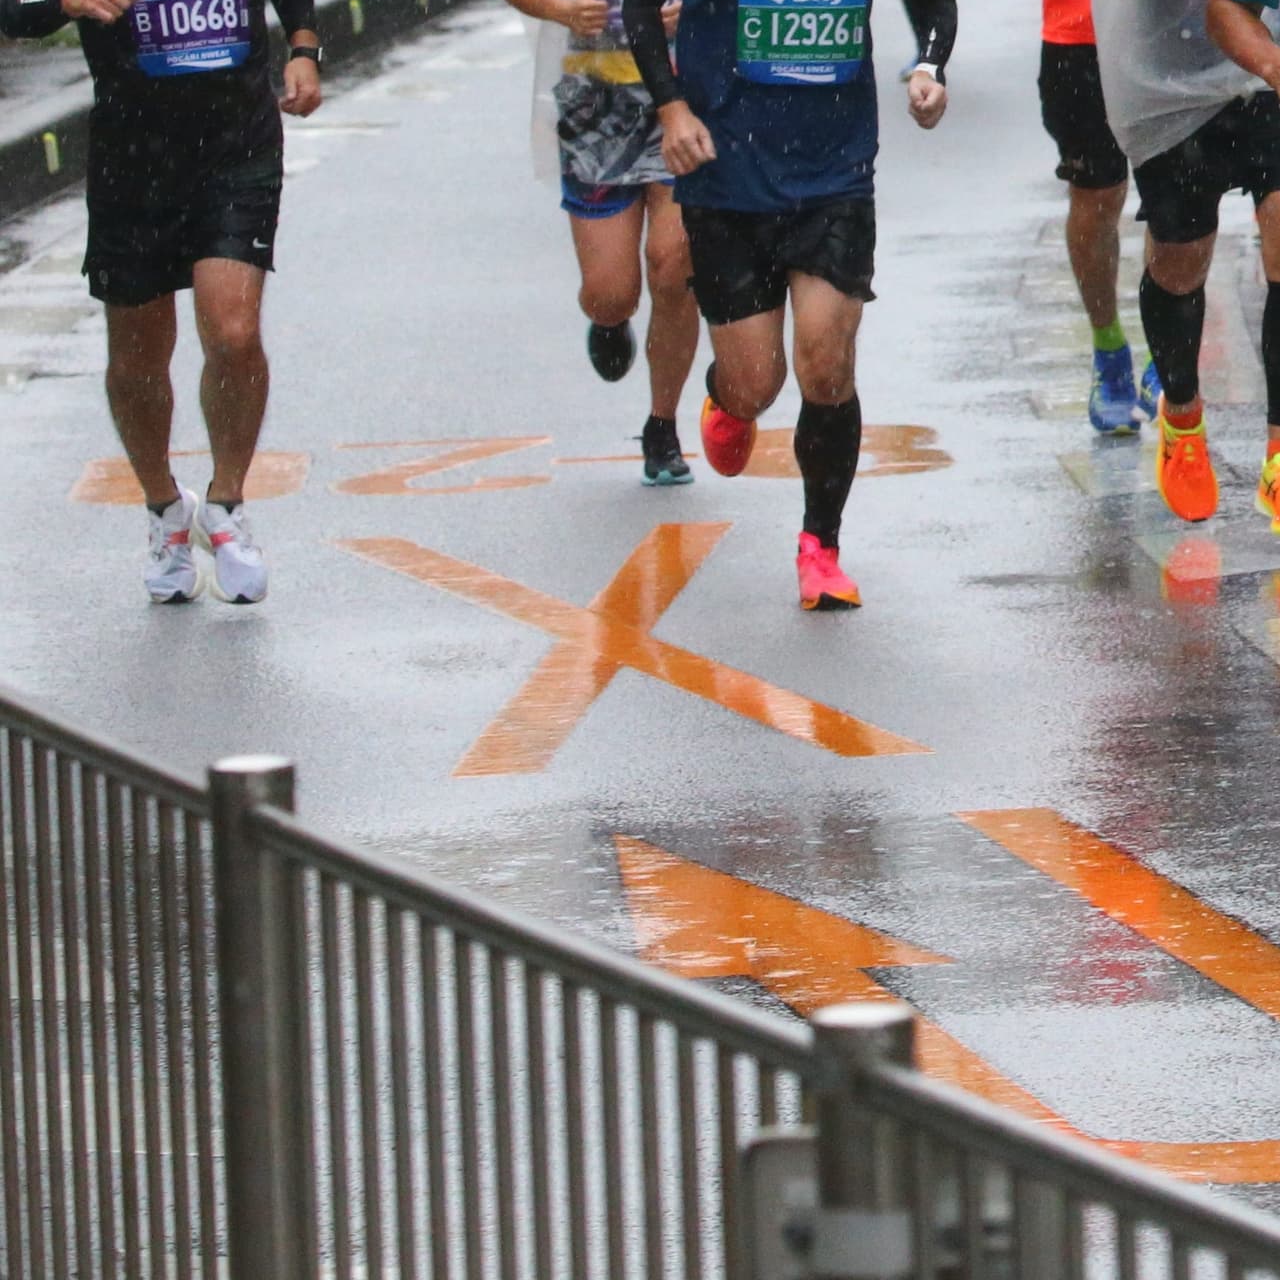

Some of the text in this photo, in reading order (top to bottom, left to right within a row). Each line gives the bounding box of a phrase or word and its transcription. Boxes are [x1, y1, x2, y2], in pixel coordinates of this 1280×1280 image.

[136, 12, 152, 33] B
[743, 11, 850, 46] C 12926
